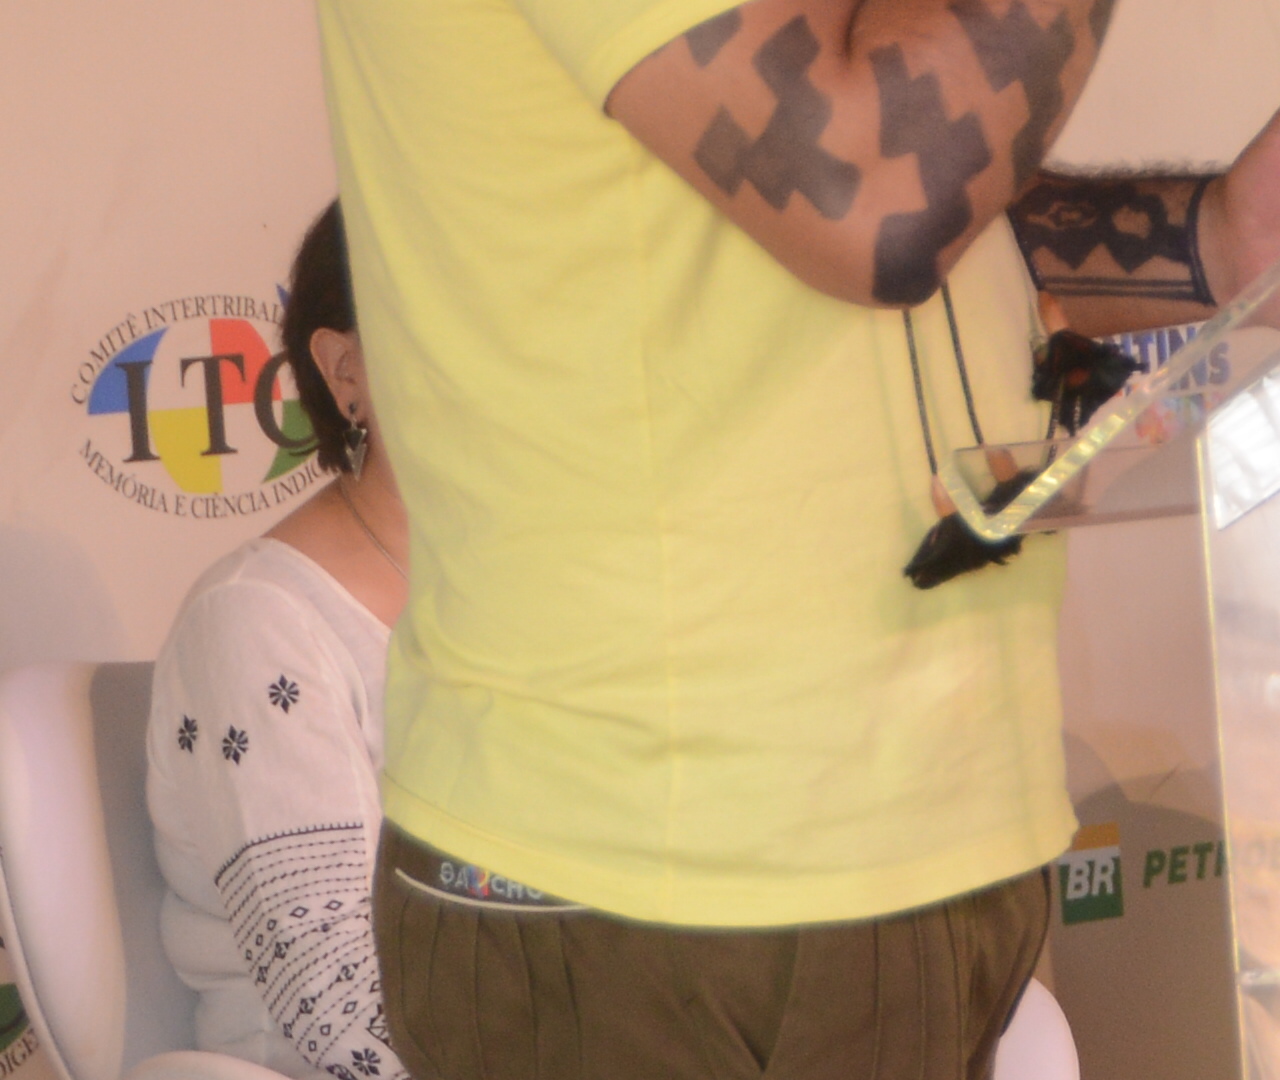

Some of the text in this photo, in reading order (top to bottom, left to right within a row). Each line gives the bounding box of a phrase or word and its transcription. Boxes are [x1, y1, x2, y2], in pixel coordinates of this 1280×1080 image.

[70, 313, 149, 406] COMITÊ
[79, 438, 270, 520] MEMÓRIA E CIÊNCIA
[1065, 856, 1117, 901] BR
